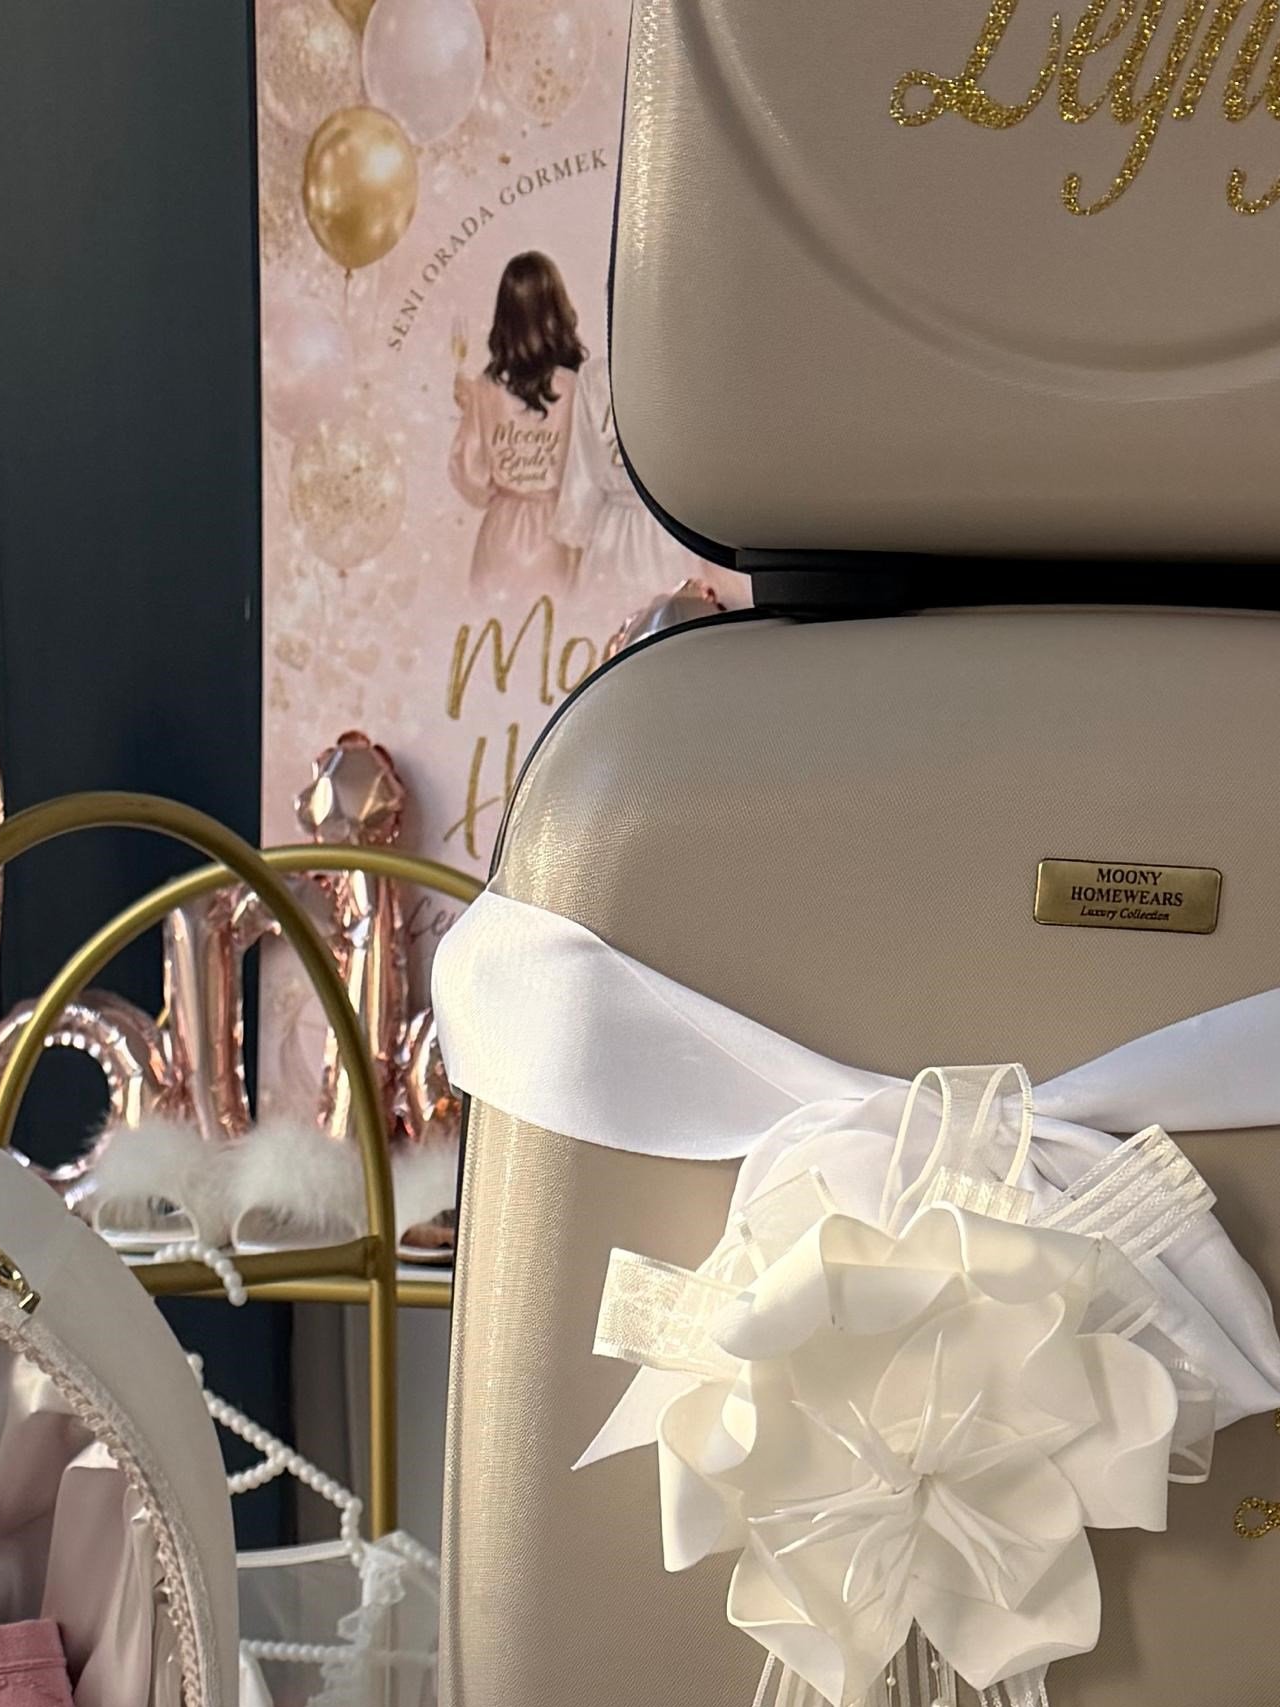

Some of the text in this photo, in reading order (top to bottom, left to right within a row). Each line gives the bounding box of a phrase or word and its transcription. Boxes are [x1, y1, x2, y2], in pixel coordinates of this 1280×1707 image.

[422, 205, 494, 284] ORADA
[445, 594, 596, 721] Mo
[1096, 868, 1163, 886] MOONY
[1071, 886, 1183, 907] HOMEWEARS
[1080, 906, 1170, 921] Luxury Collection
